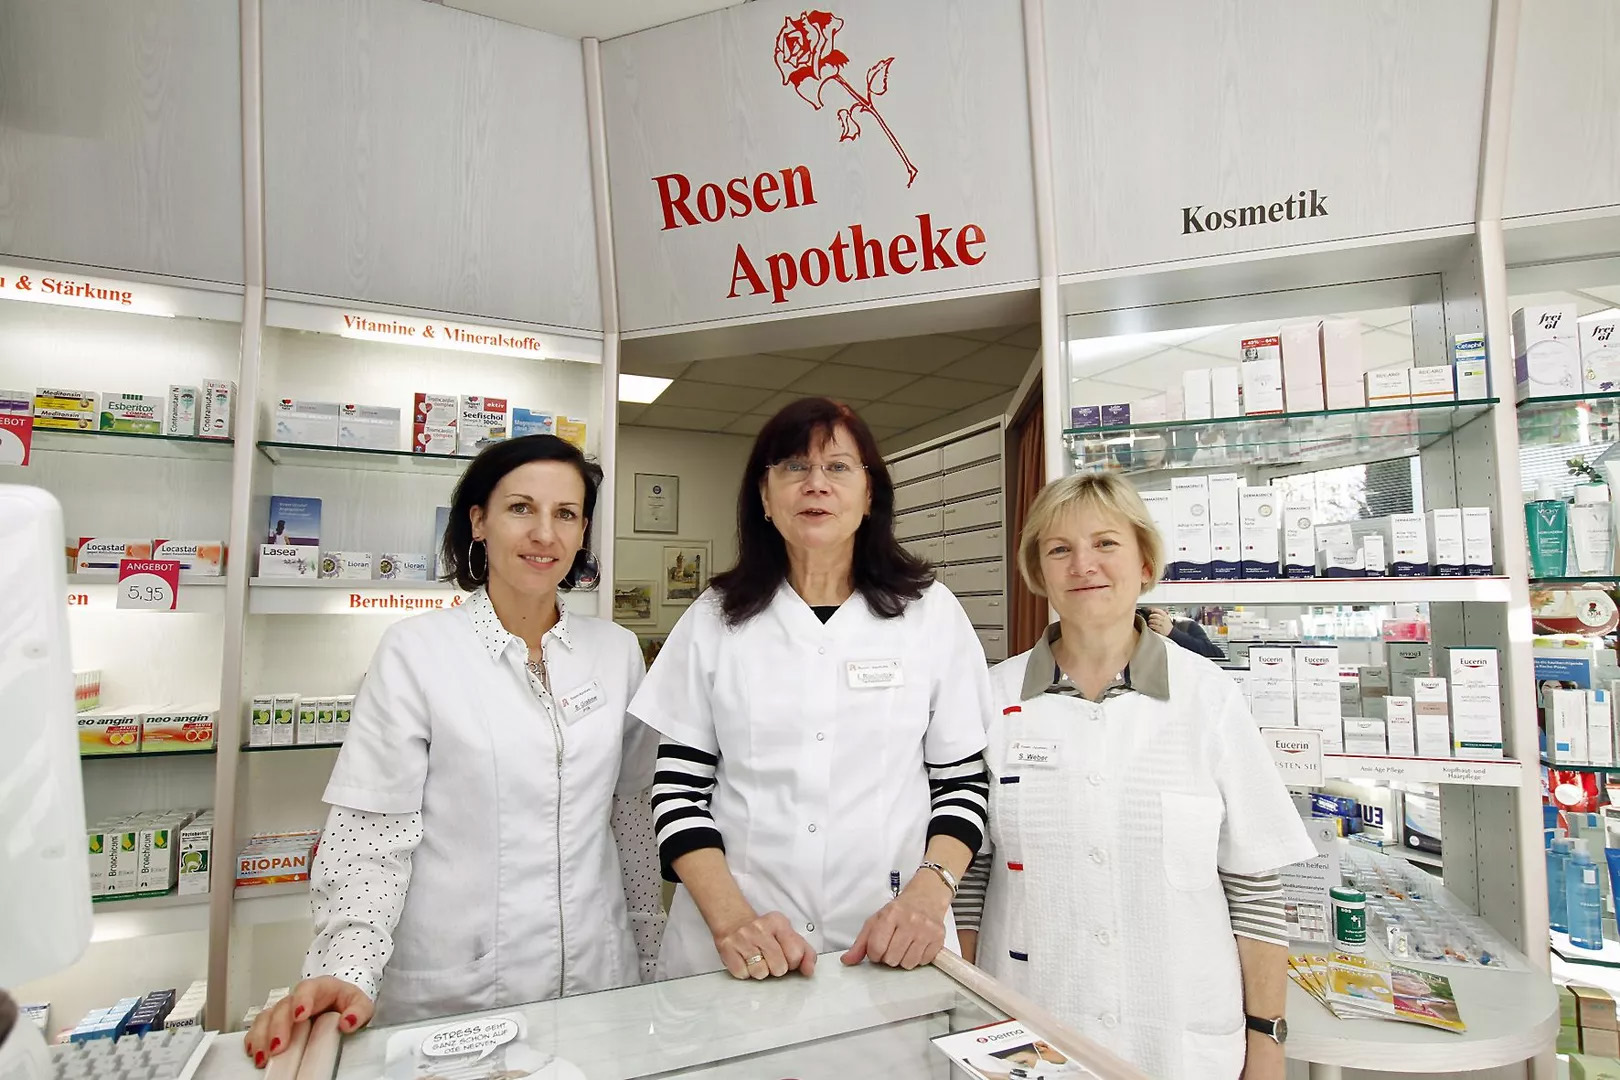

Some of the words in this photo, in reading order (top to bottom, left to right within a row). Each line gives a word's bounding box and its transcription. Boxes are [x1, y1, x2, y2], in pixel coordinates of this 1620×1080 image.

[651, 163, 818, 232] Rosen
[1180, 189, 1329, 235] Kosmetik
[726, 213, 988, 305] Apotheke
[15, 275, 32, 290] &
[41, 277, 133, 305] Stärkung
[1538, 312, 1562, 325] frei
[343, 314, 416, 336] Vitamine
[423, 324, 435, 338] &
[443, 326, 541, 351] Mineralstoffe
[1592, 324, 1615, 337] frei
[42, 389, 81, 398] Meditonsin
[108, 401, 155, 412] Esberitox
[41, 410, 80, 418] Meditonsin
[87, 543, 125, 551] Locastad
[161, 545, 197, 553] Locastad
[263, 547, 296, 557] Lasea
[126, 563, 175, 571] ANGEBOT
[349, 594, 443, 610] Beruhigung
[97, 717, 134, 725] angin
[173, 714, 209, 723] angin
[1275, 740, 1309, 750] Eucerin
[108, 835, 119, 877] Bronchicum
[141, 833, 152, 874] Bronchicum
[241, 856, 306, 872] RIOPAN
[165, 1019, 194, 1030] Livocab
[433, 1025, 481, 1042] STRESS
[484, 1022, 507, 1033] GEHT
[988, 1029, 1024, 1041] Derma
[431, 1041, 457, 1050] GANZ
[492, 1029, 508, 1038] AUF
[463, 1040, 497, 1050] NERVEN
